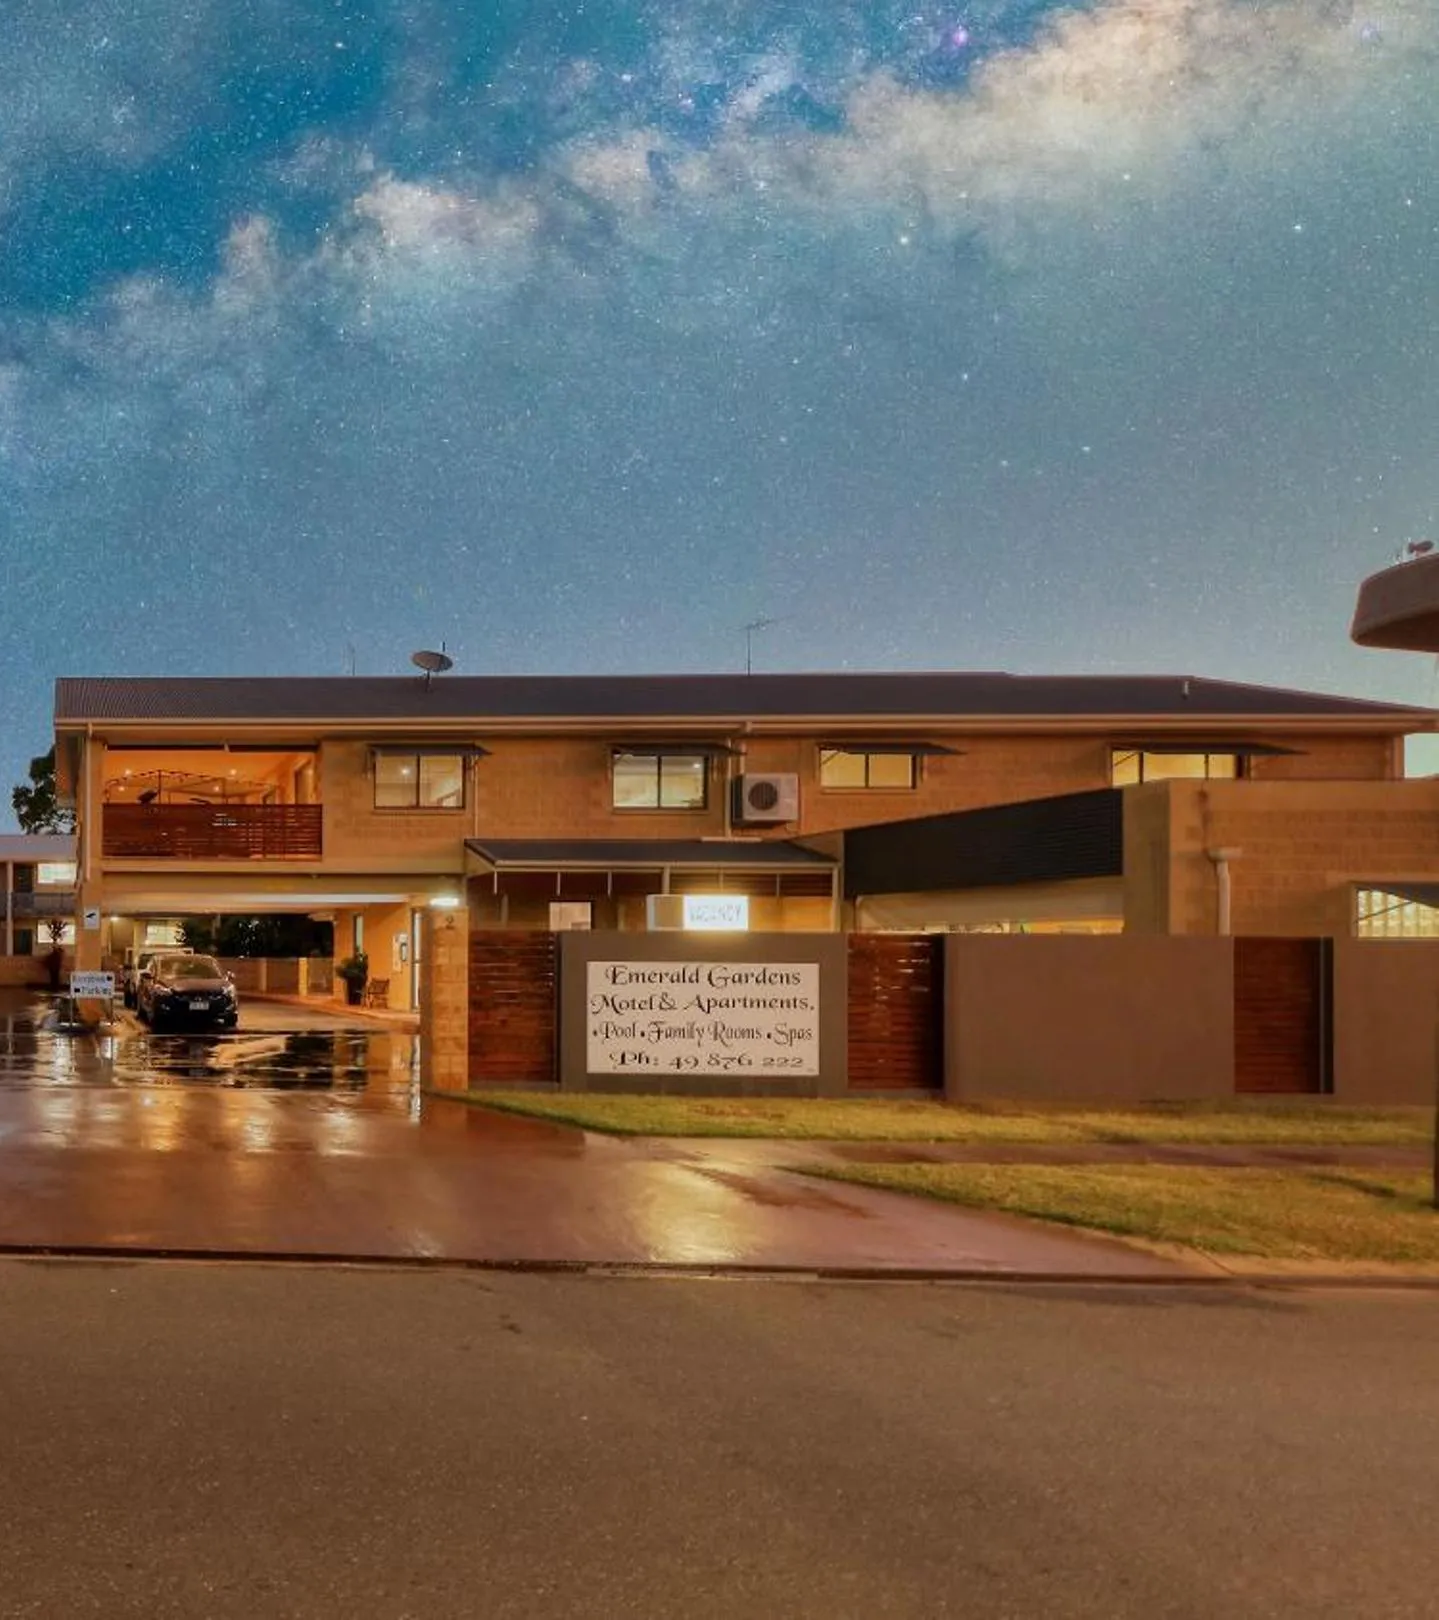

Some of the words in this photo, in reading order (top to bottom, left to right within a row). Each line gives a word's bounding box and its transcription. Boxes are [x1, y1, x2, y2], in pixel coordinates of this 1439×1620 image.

[605, 965, 702, 985] Emerald
[707, 966, 801, 989] Gardens
[591, 994, 656, 1015] Motel
[659, 992, 678, 1010] &
[600, 1021, 638, 1045] Pool
[648, 1021, 705, 1047] Family
[707, 1021, 762, 1047] Rooms
[774, 1022, 813, 1047] Spas
[609, 1051, 659, 1069] Ph:
[669, 1056, 699, 1070] 49
[707, 1052, 753, 1070] 876
[762, 1056, 804, 1069] 222
